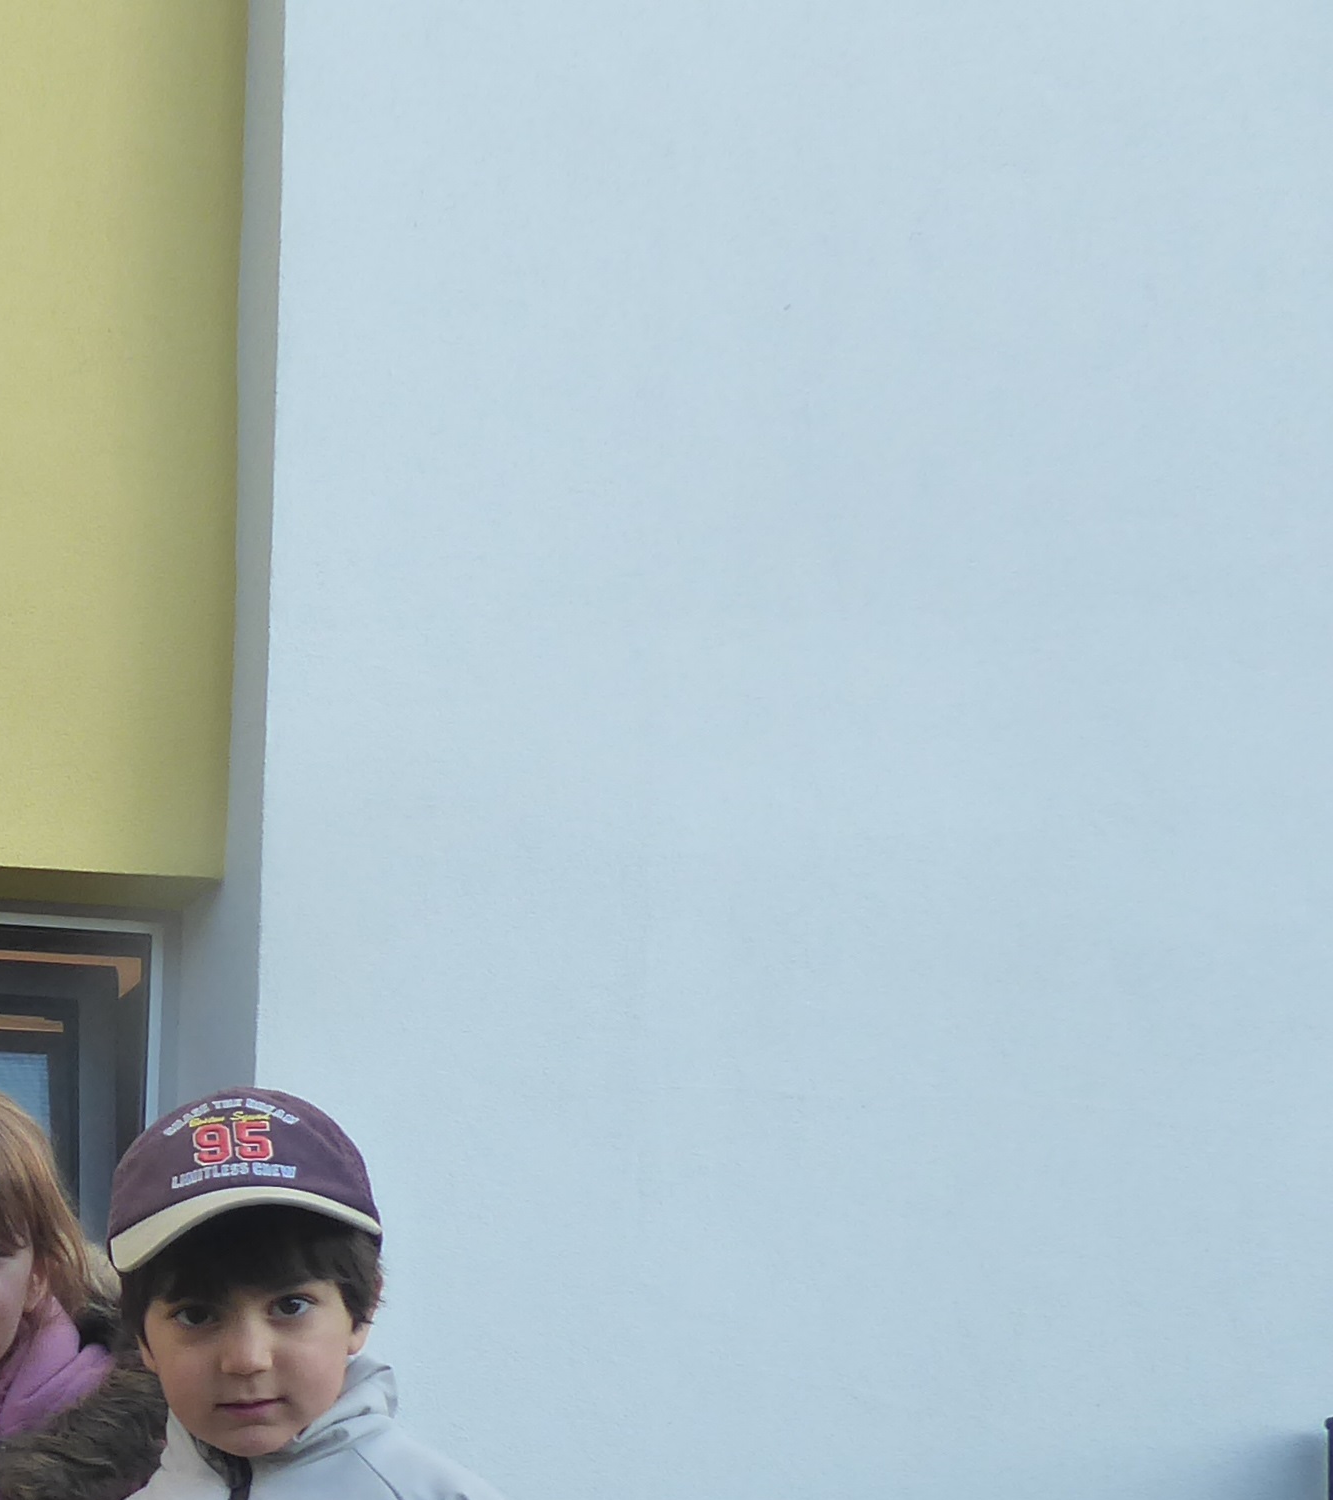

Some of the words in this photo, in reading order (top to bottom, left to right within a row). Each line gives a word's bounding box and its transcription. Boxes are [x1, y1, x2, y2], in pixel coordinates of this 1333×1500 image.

[193, 1121, 273, 1166] 95
[171, 1162, 249, 1189] LIMITLESS
[252, 1162, 297, 1179] CREW
